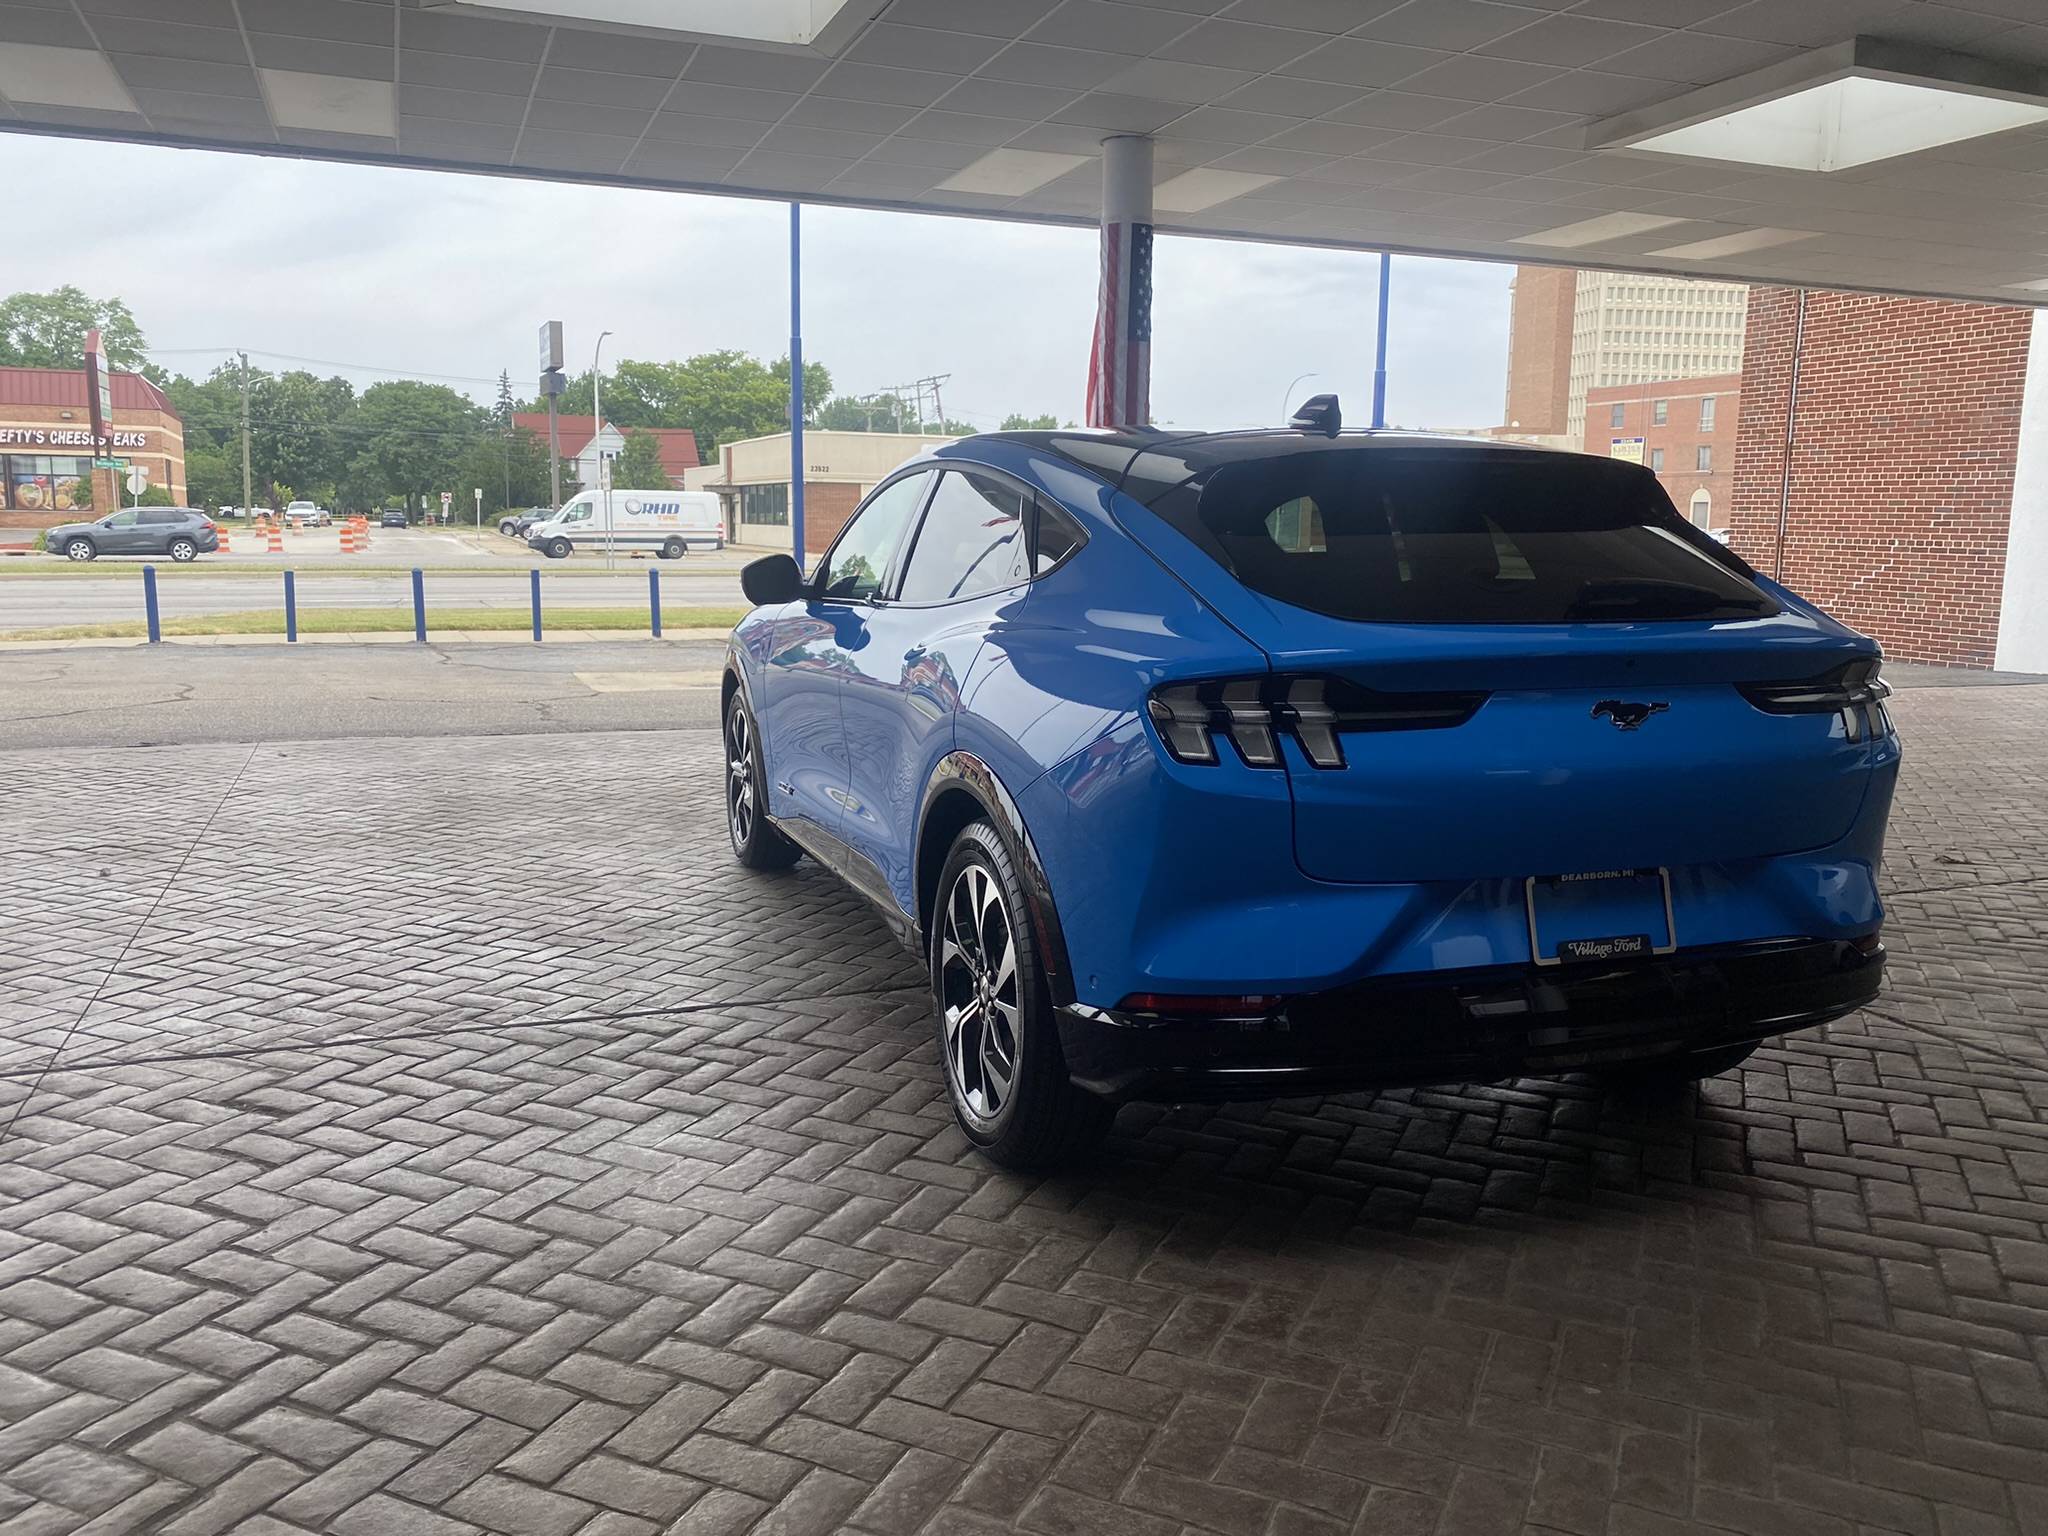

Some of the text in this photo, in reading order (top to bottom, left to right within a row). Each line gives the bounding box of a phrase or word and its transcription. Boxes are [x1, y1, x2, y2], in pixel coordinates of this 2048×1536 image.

[50, 430, 146, 447] CHEESSEAKS
[1622, 868, 1634, 878] MI
[1568, 937, 1642, 959] Village Ford
